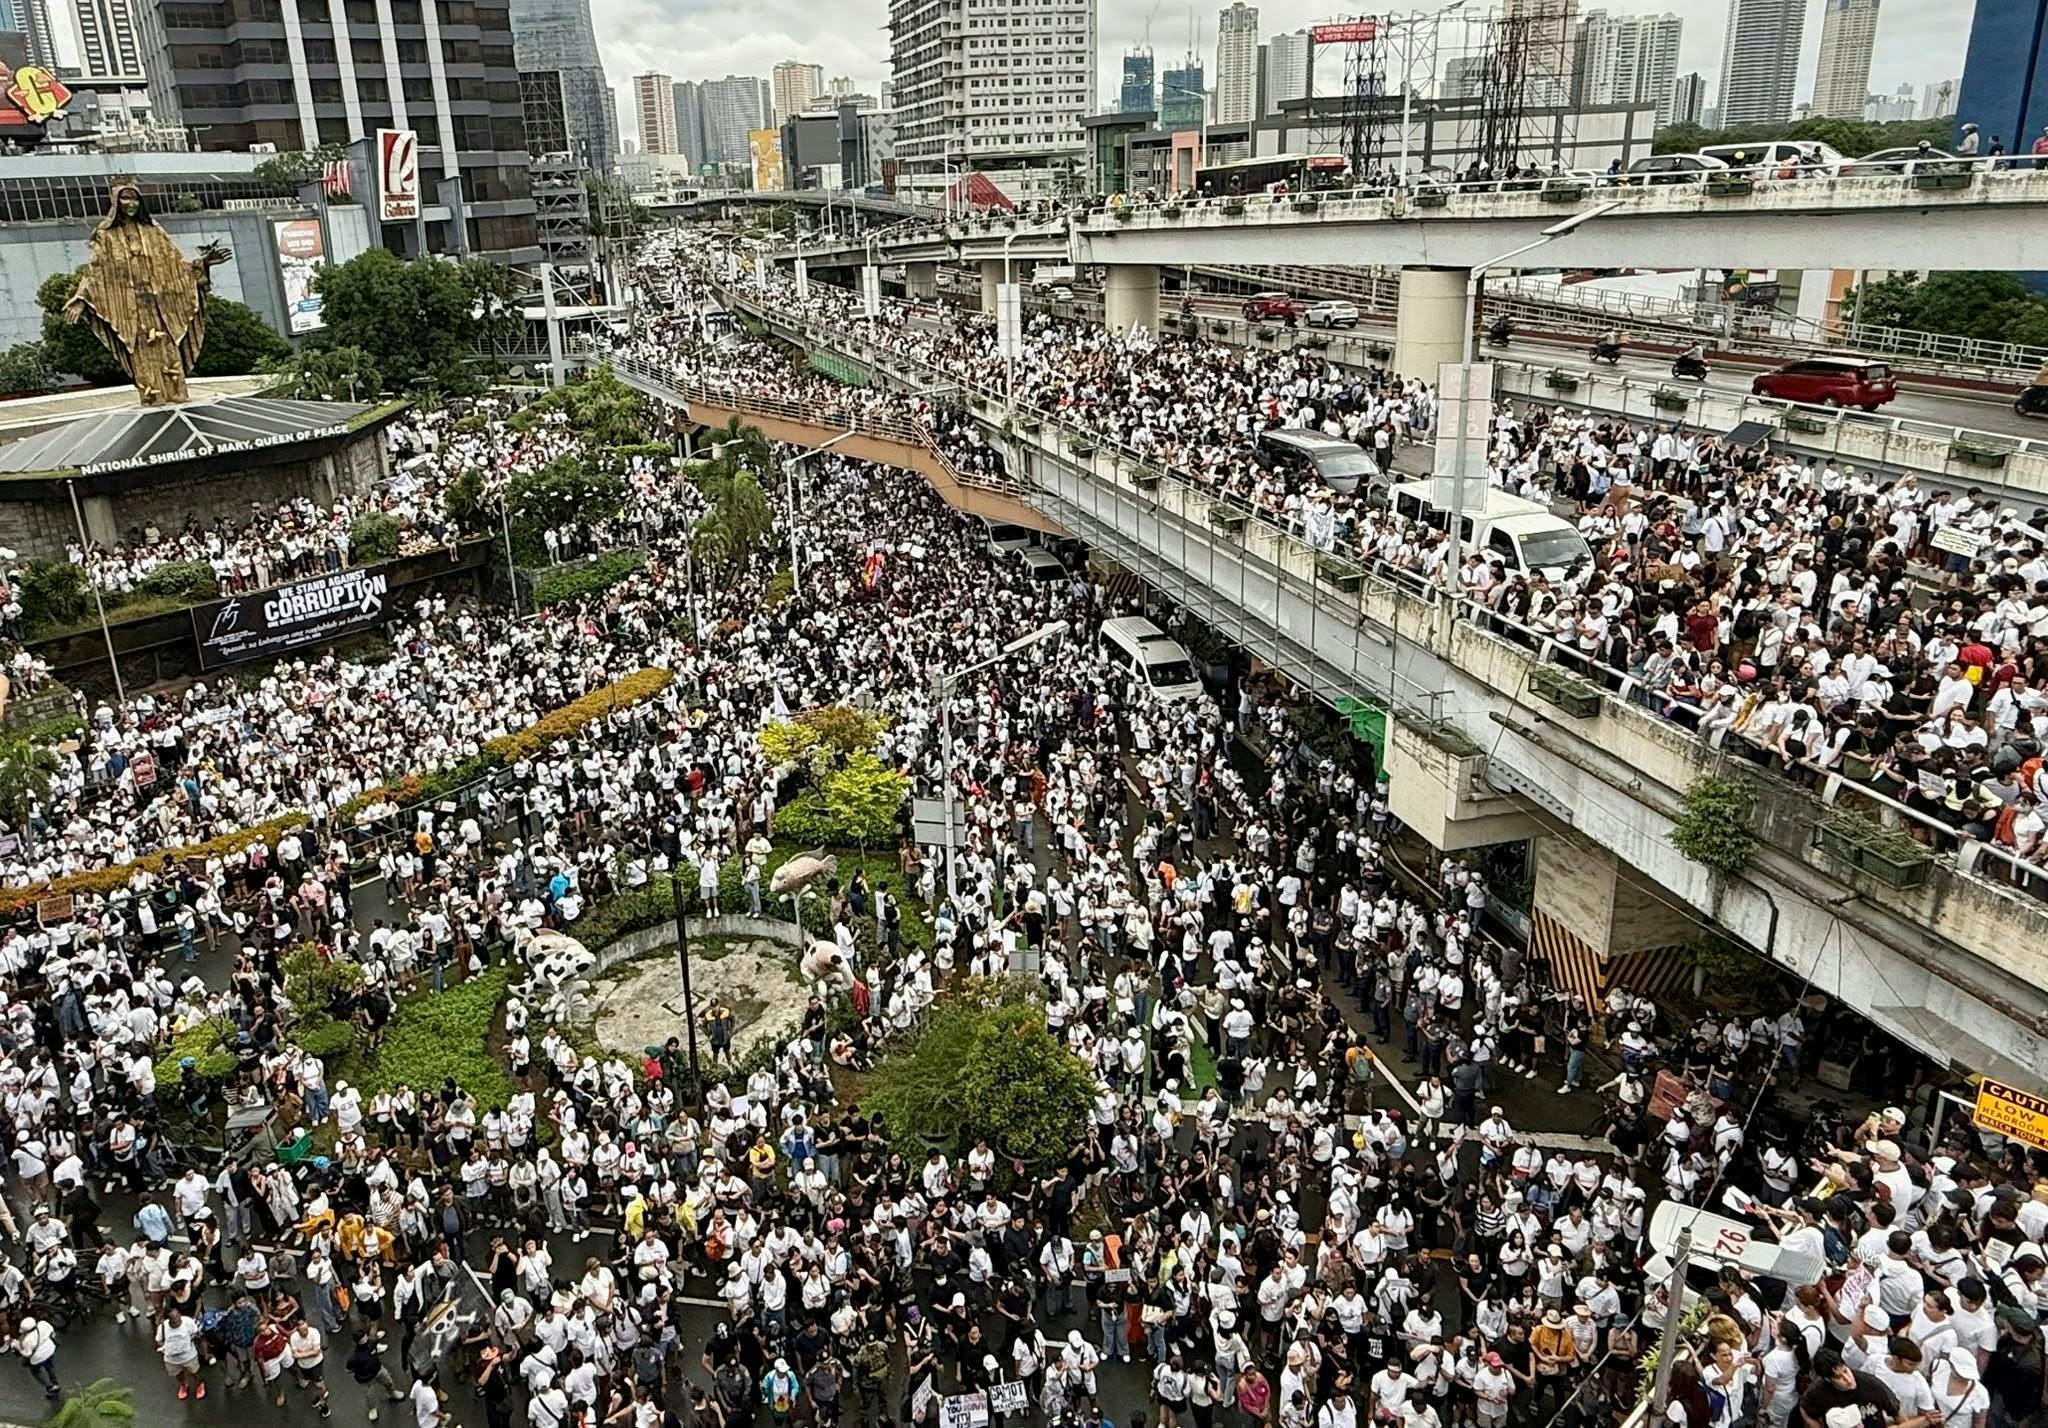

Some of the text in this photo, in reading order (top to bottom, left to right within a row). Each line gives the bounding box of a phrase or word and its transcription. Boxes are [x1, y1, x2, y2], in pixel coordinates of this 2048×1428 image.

[80, 424, 349, 475] NATIONAL SHRINE OF MARY, QUEEN OF PEACE
[278, 569, 366, 598] WE STAND AGAINST
[264, 574, 387, 622] CORRUPTION
[1990, 1085, 2048, 1113] CAUTI
[1995, 1101, 2036, 1122] LOW
[1980, 1116, 2041, 1143] WATCH YOUR
[1982, 1106, 2044, 1135] HEADROOM
[991, 1383, 1023, 1400] GAMOT
[946, 1404, 962, 1414] YOU
[948, 1412, 971, 1423] WITH
